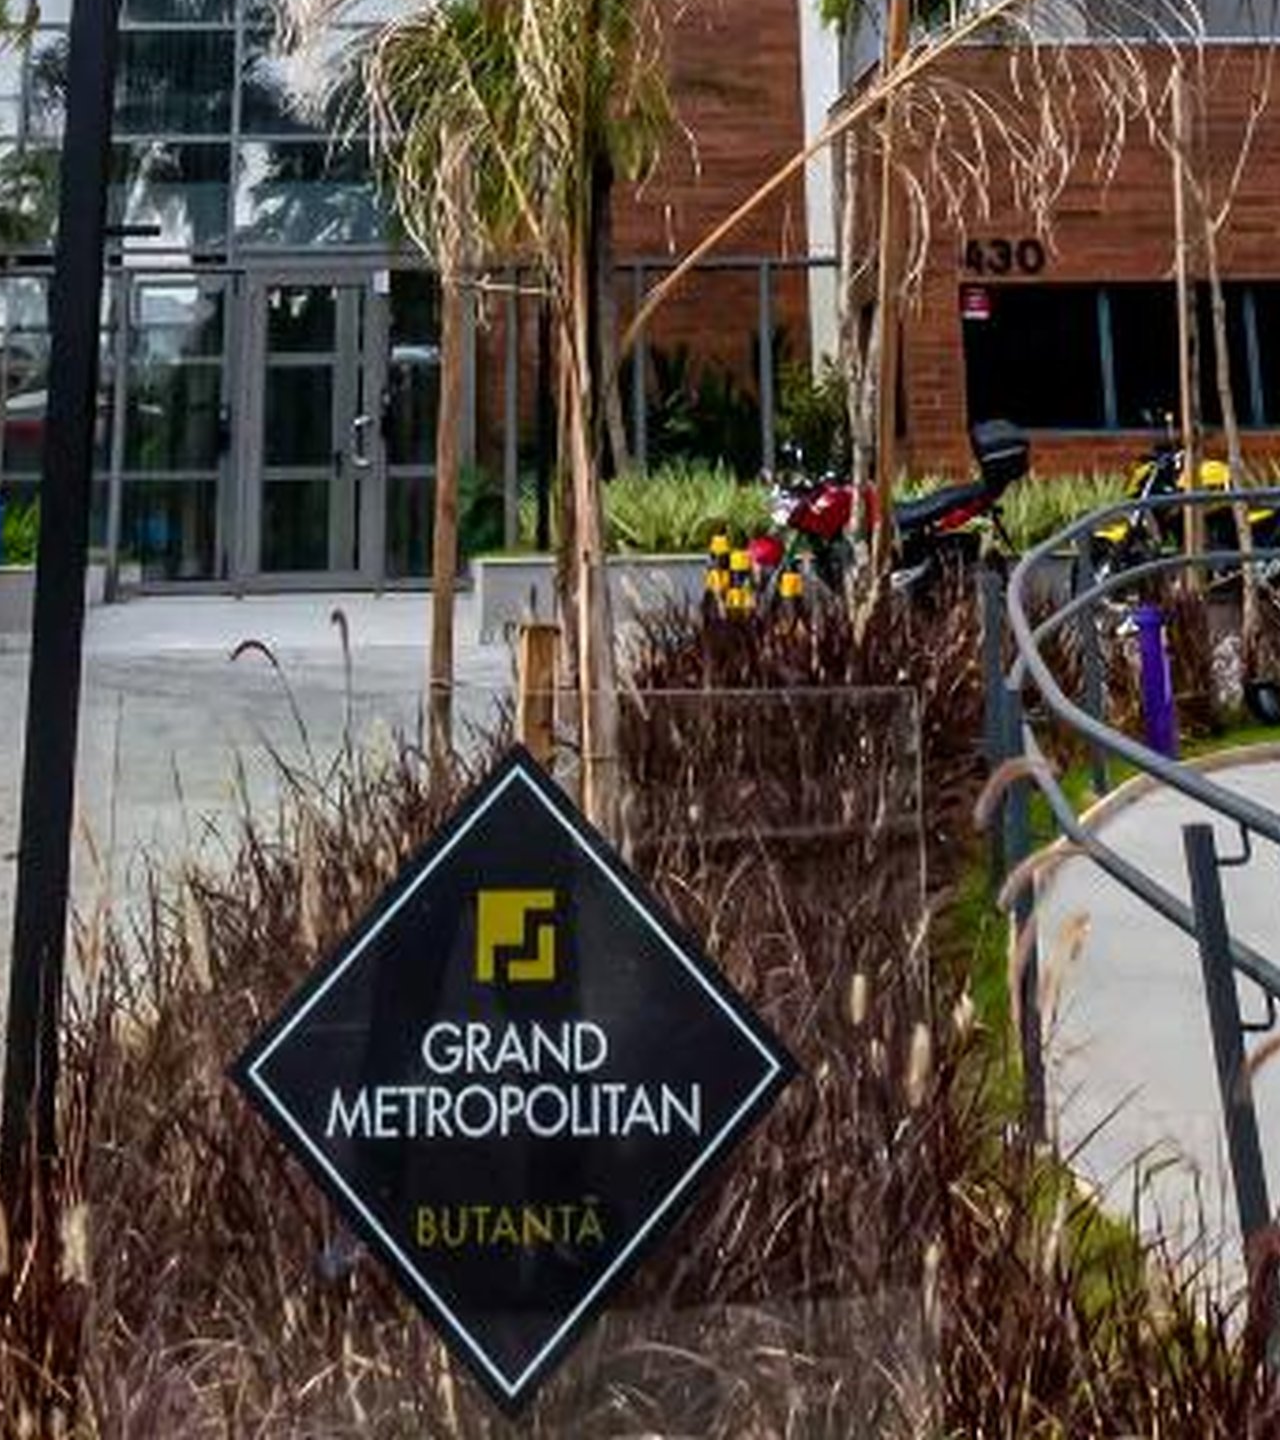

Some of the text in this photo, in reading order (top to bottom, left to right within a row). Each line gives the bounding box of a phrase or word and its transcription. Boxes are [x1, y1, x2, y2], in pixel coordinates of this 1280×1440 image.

[421, 1021, 608, 1074] GRAND
[325, 1083, 702, 1139] METROPOLITAN
[417, 1194, 603, 1248] BUTANTÃ
